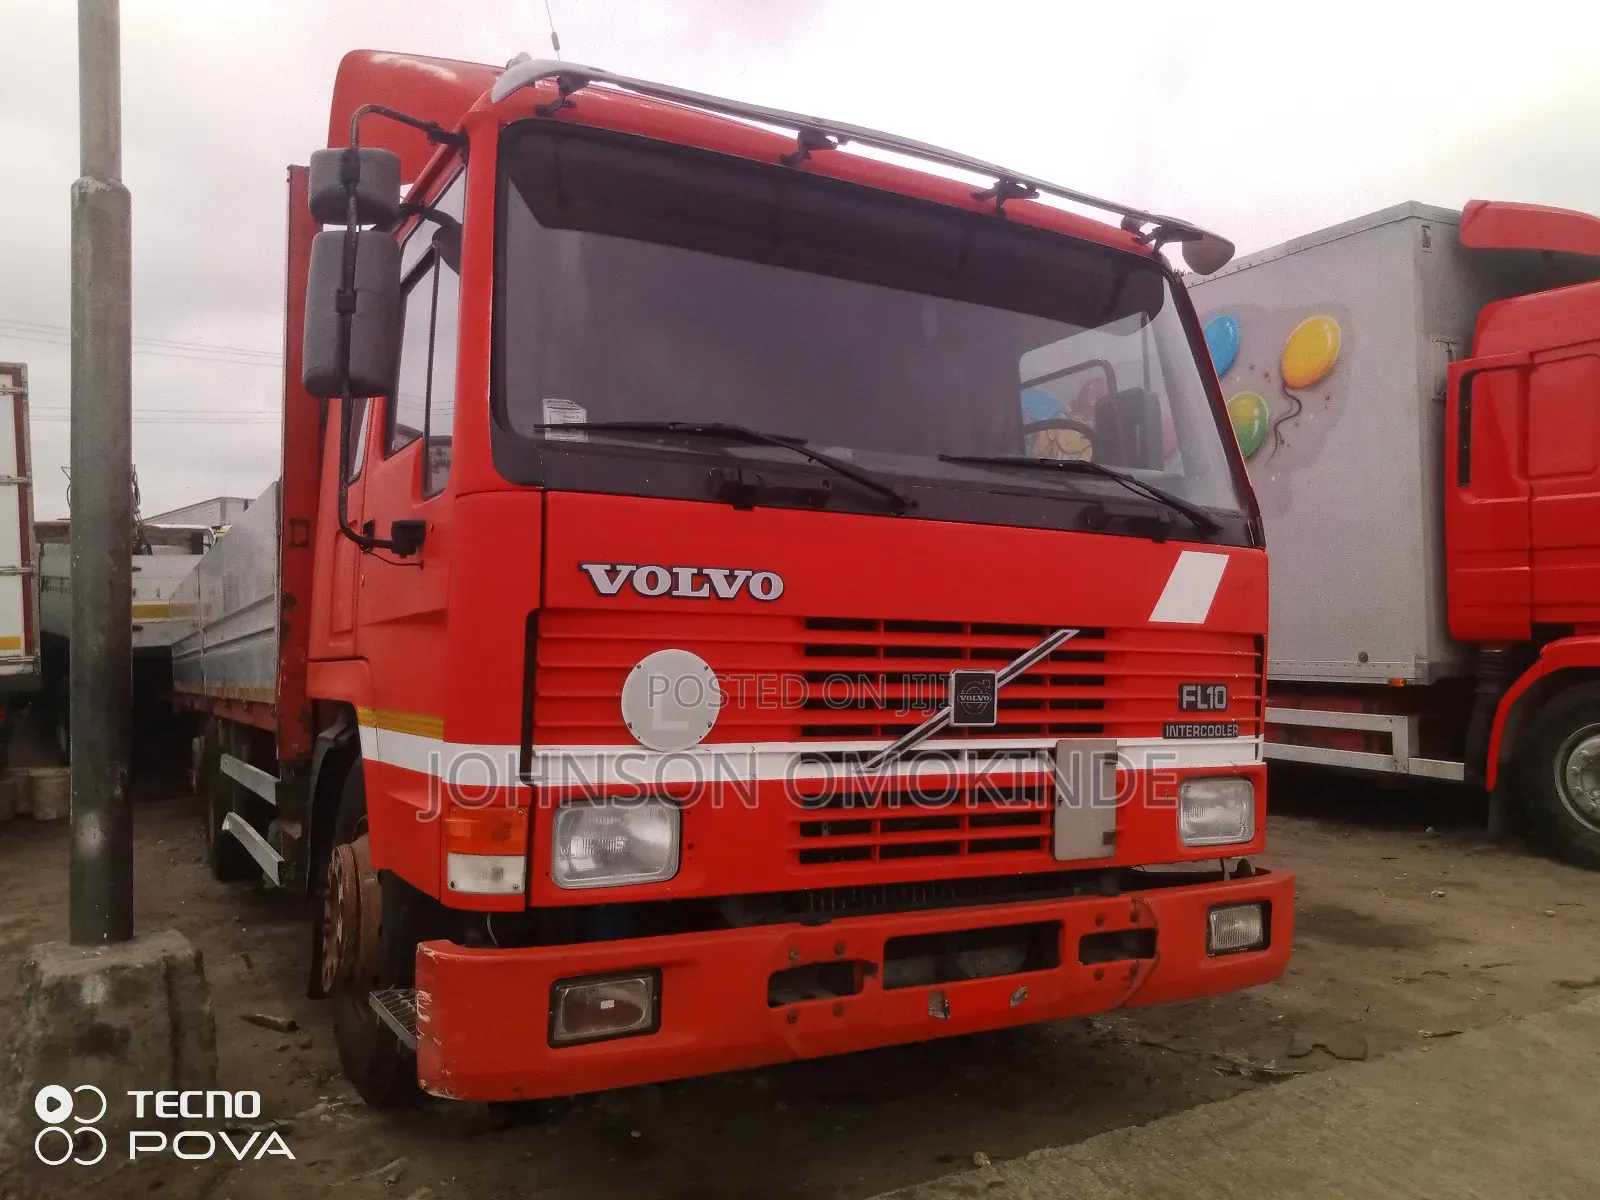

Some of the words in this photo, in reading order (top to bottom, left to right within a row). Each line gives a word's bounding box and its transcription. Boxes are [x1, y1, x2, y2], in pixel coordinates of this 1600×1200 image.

[579, 562, 786, 602] VOLVO
[1182, 685, 1227, 709] FL10
[1165, 724, 1239, 737] INTERCOOLER
